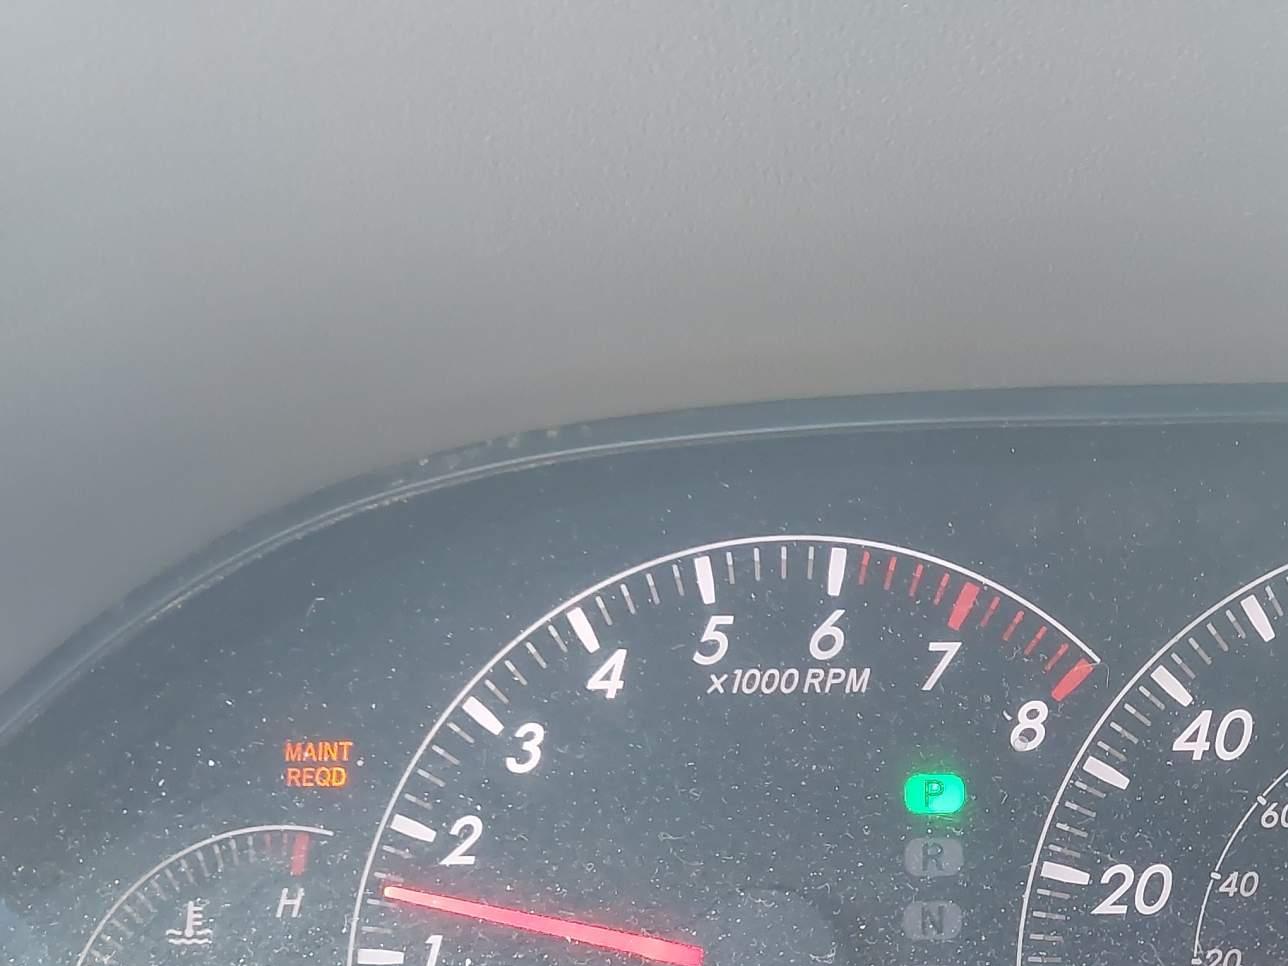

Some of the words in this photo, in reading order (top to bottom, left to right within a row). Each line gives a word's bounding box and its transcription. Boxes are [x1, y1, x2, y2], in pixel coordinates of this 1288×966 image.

[693, 615, 735, 666] 5
[809, 609, 846, 661] 6
[587, 648, 627, 699] 4
[803, 667, 871, 694] RPM
[921, 641, 962, 691] 7
[284, 740, 354, 762] MAINT
[505, 722, 546, 774] 3
[1010, 700, 1048, 752] 8
[1172, 708, 1254, 761] 40
[285, 766, 347, 788] REQD
[924, 779, 945, 808] P
[439, 815, 484, 866] 2
[275, 887, 305, 918] H
[1090, 863, 1173, 915] 20
[1219, 870, 1260, 898] 40
